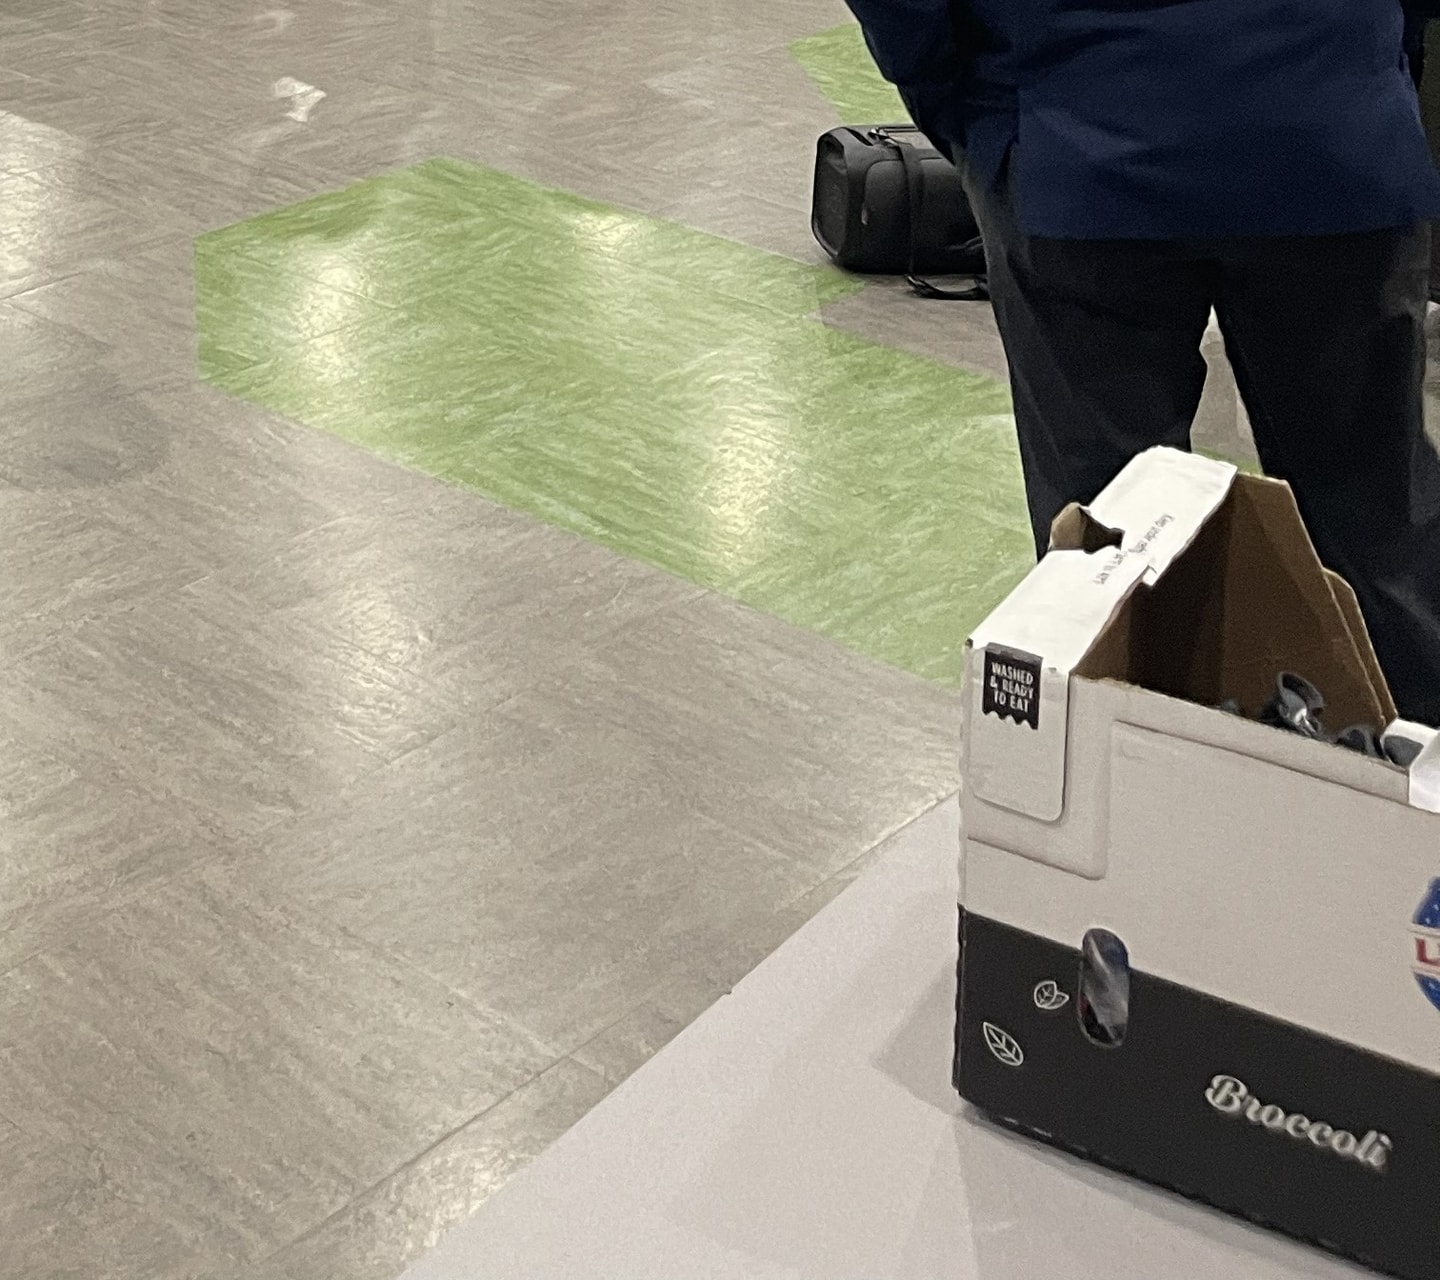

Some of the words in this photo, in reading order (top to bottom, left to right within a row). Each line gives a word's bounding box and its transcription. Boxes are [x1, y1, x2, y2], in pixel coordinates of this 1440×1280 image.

[991, 661, 1034, 686] WASHED
[990, 675, 999, 689] &
[1002, 678, 1034, 700] READY
[994, 689, 1006, 706] TO
[1010, 695, 1030, 713] EAT
[1204, 1074, 1394, 1167] Broccoli
